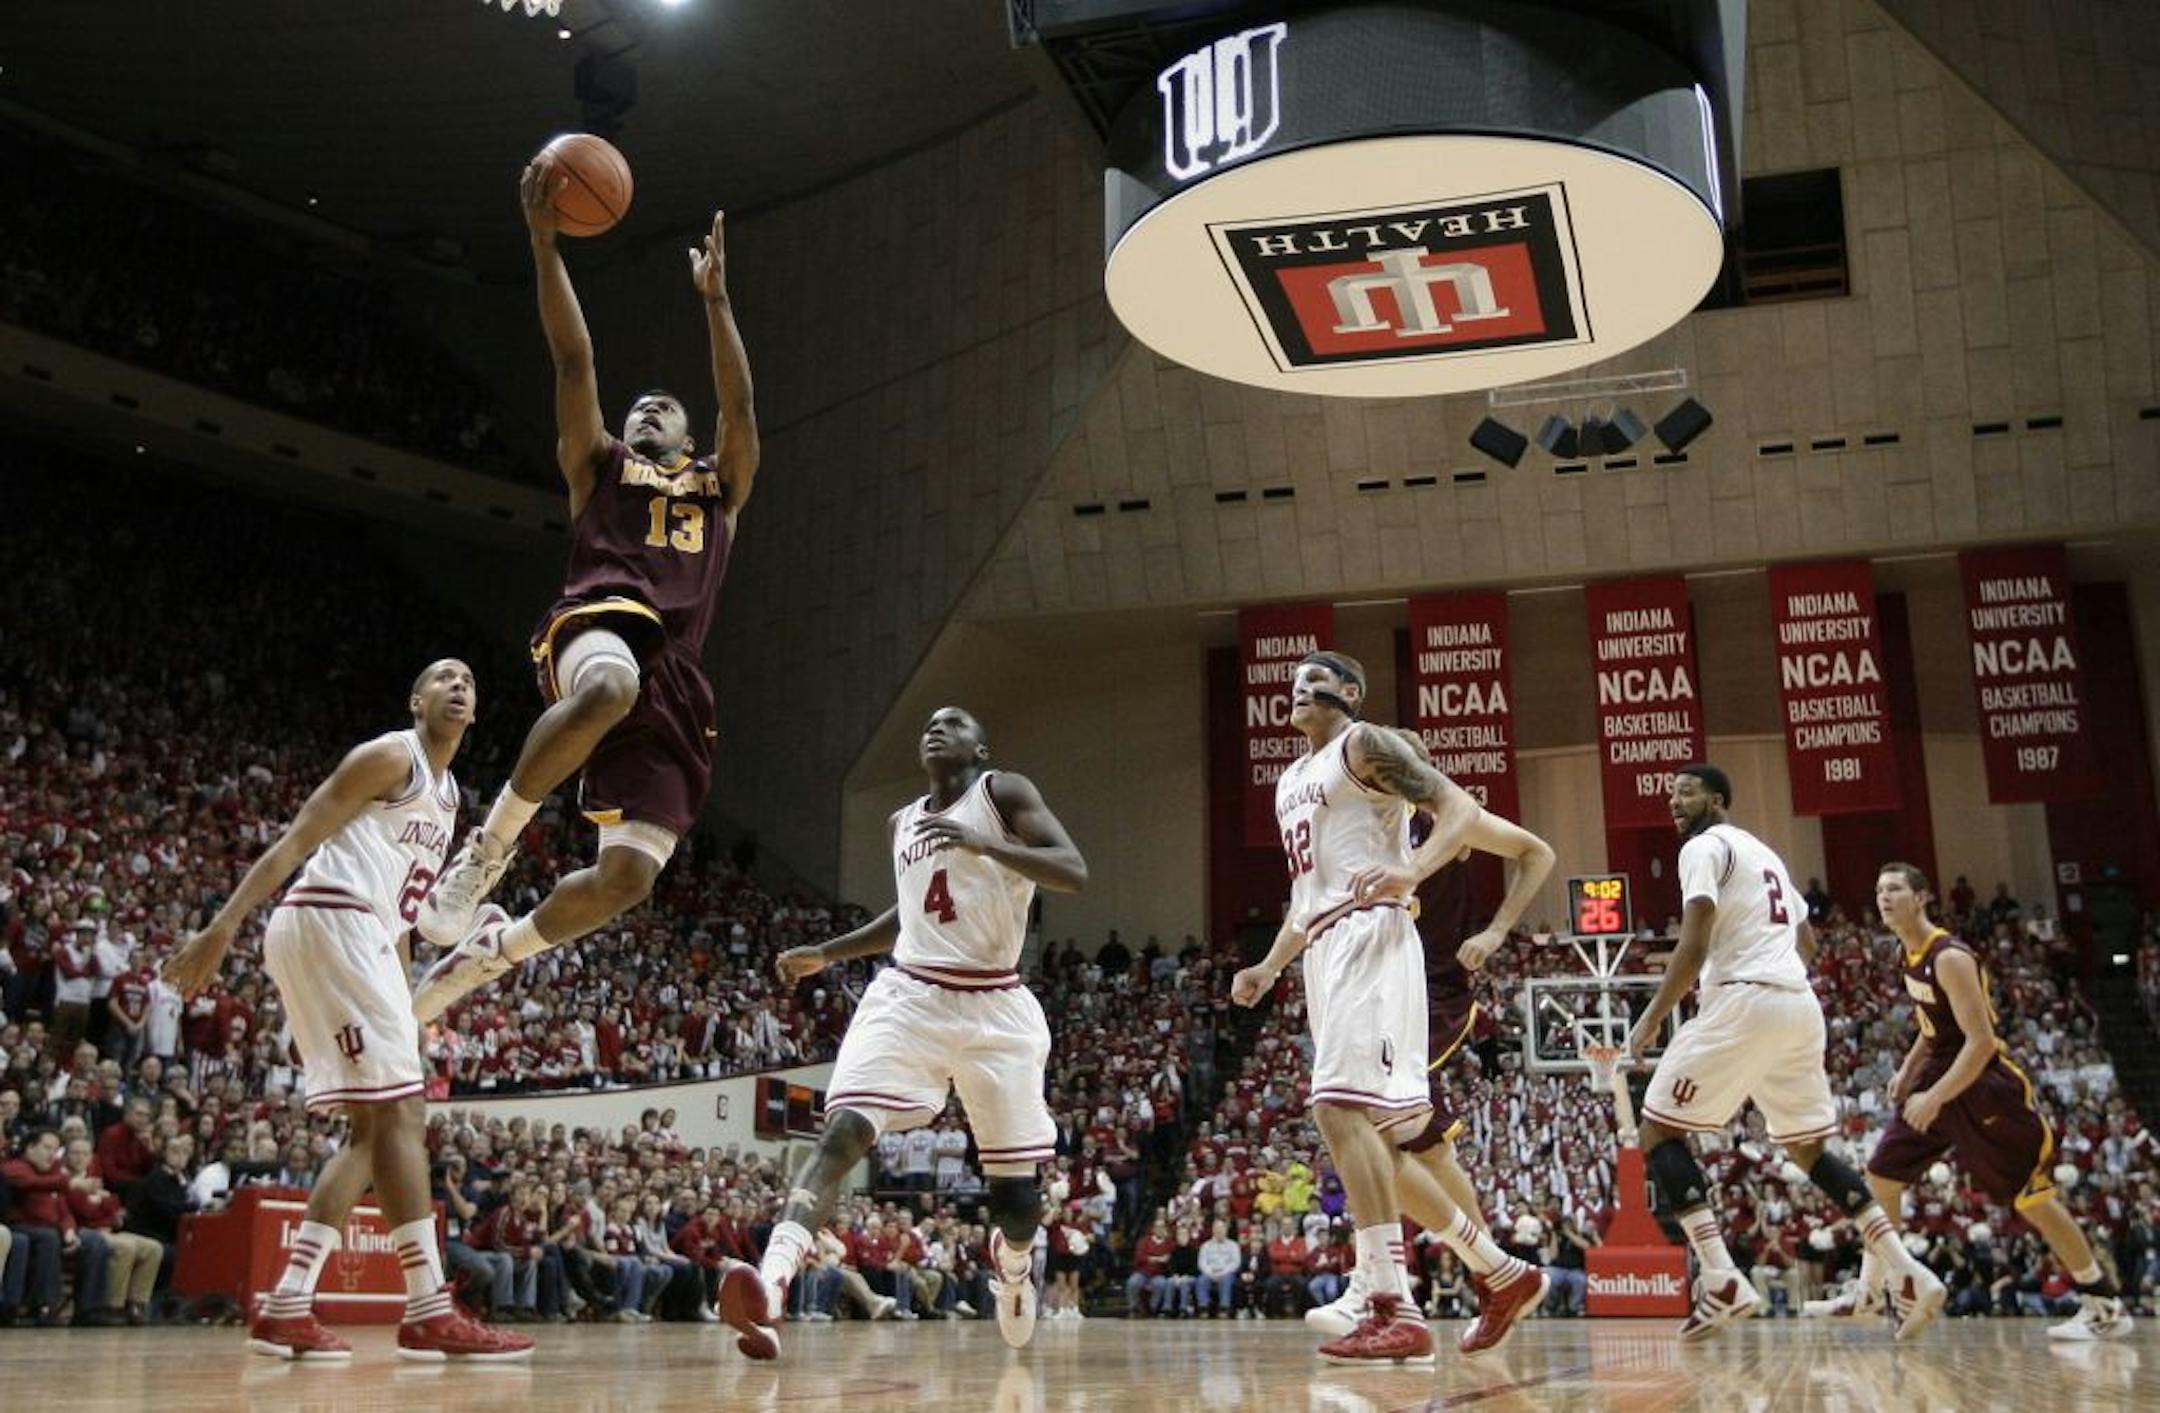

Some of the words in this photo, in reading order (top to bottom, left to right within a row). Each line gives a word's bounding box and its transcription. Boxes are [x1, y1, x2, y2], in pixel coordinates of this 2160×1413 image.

[1252, 206, 1531, 257] HEALTH
[645, 496, 704, 553] 13
[1980, 576, 2052, 602] INDIANA
[1788, 592, 1859, 617] INDIANA
[1972, 602, 2065, 629] UNIVERSITY
[1606, 608, 1674, 633] INDIANA
[1779, 617, 1871, 644] UNIVERSITY
[1256, 634, 1319, 659] INDIANA
[1427, 623, 1492, 648] INDIANA
[1598, 632, 1686, 661] UNIVERSITY
[1419, 648, 1503, 674] UNIVERSITY
[1781, 650, 1881, 690] NCAA
[1973, 636, 2076, 677] NCAA
[1247, 661, 1295, 684] UNIVER
[1598, 665, 1693, 705] NCAA
[1419, 681, 1508, 718] NCAA
[1789, 695, 1882, 724] BASKETBALL
[1981, 681, 2078, 711] BASKETBALL
[1247, 694, 1289, 727] NC
[1990, 709, 2079, 738] CHAMPIONS
[1423, 725, 1507, 750] BASKETBALL
[1604, 711, 1694, 738] BASKETBALL
[1795, 721, 1881, 750] CHAMPIONS
[1250, 736, 1309, 759] BASKETB
[1610, 739, 1693, 764] CHAMPIONS
[2017, 746, 2059, 771] 1987
[1824, 758, 1862, 782] 1981
[1636, 773, 1676, 796] 1976
[399, 820, 447, 853] INDIA
[925, 868, 958, 924] 4
[1583, 880, 1621, 899] 9:02
[1763, 868, 1789, 924] 2
[1580, 900, 1620, 932] 26
[1587, 1273, 1681, 1296] Smithville
